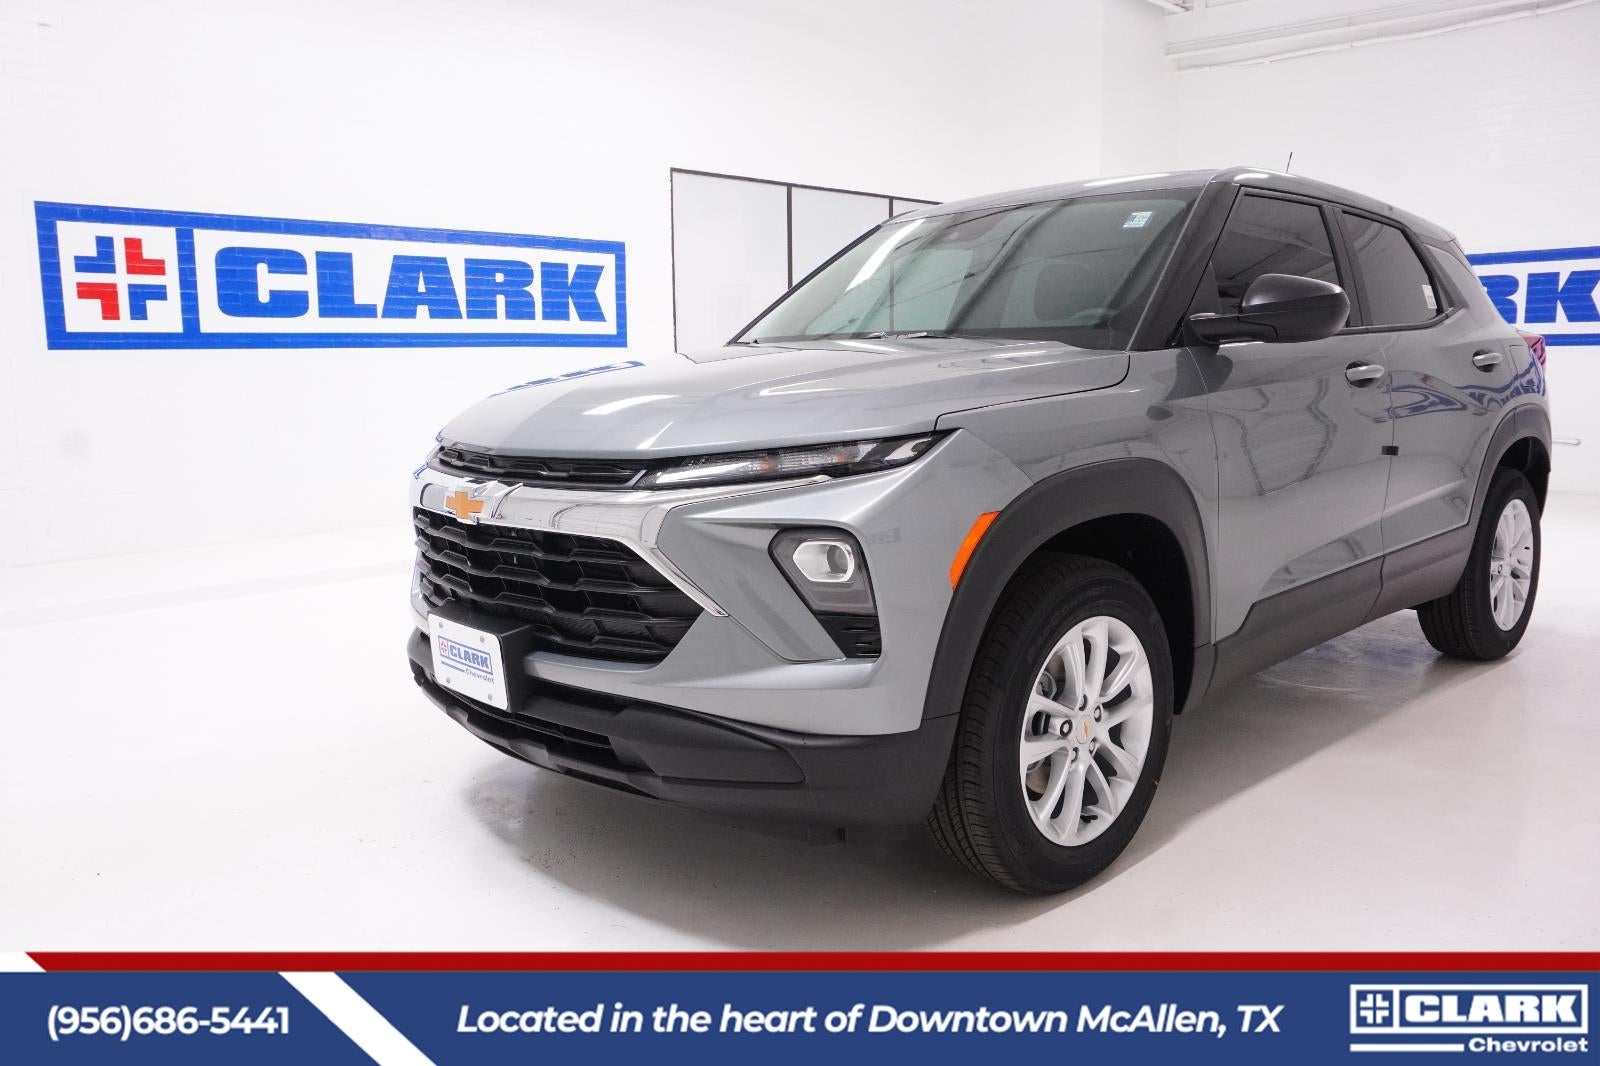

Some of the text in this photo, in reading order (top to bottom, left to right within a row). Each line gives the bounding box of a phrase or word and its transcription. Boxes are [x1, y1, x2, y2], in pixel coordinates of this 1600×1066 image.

[214, 246, 608, 322] CLARK
[449, 644, 490, 669] CLARK
[465, 668, 495, 684] Chevrolet
